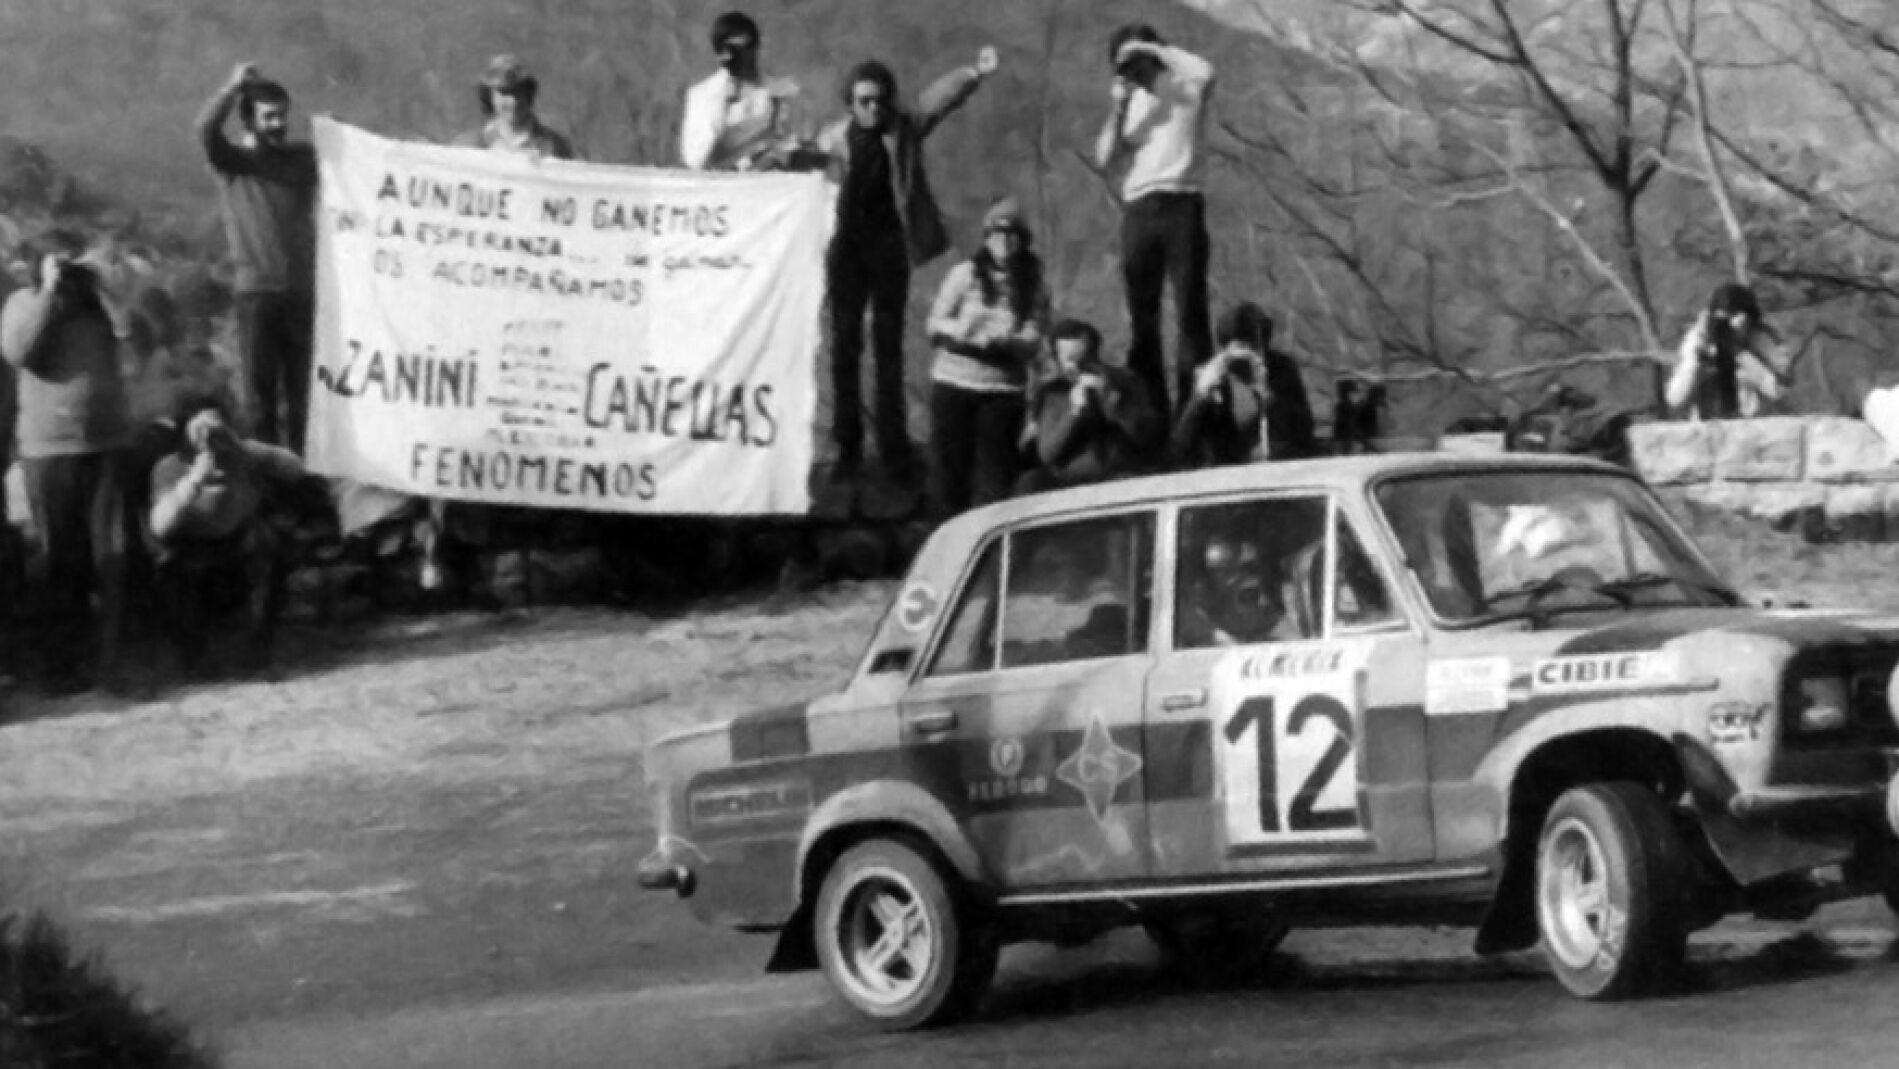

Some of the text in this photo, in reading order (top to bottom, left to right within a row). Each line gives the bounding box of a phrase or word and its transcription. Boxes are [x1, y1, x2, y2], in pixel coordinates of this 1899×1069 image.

[375, 216, 404, 240] LA
[377, 173, 513, 221] AUNQUE
[542, 197, 577, 227] NO
[592, 198, 729, 238] GANEMOS
[373, 248, 643, 307] OS ACOMPAÑAMOS
[319, 338, 478, 409] ZANINI
[409, 442, 659, 502] FENOMENOS
[1222, 692, 1360, 834] 12
